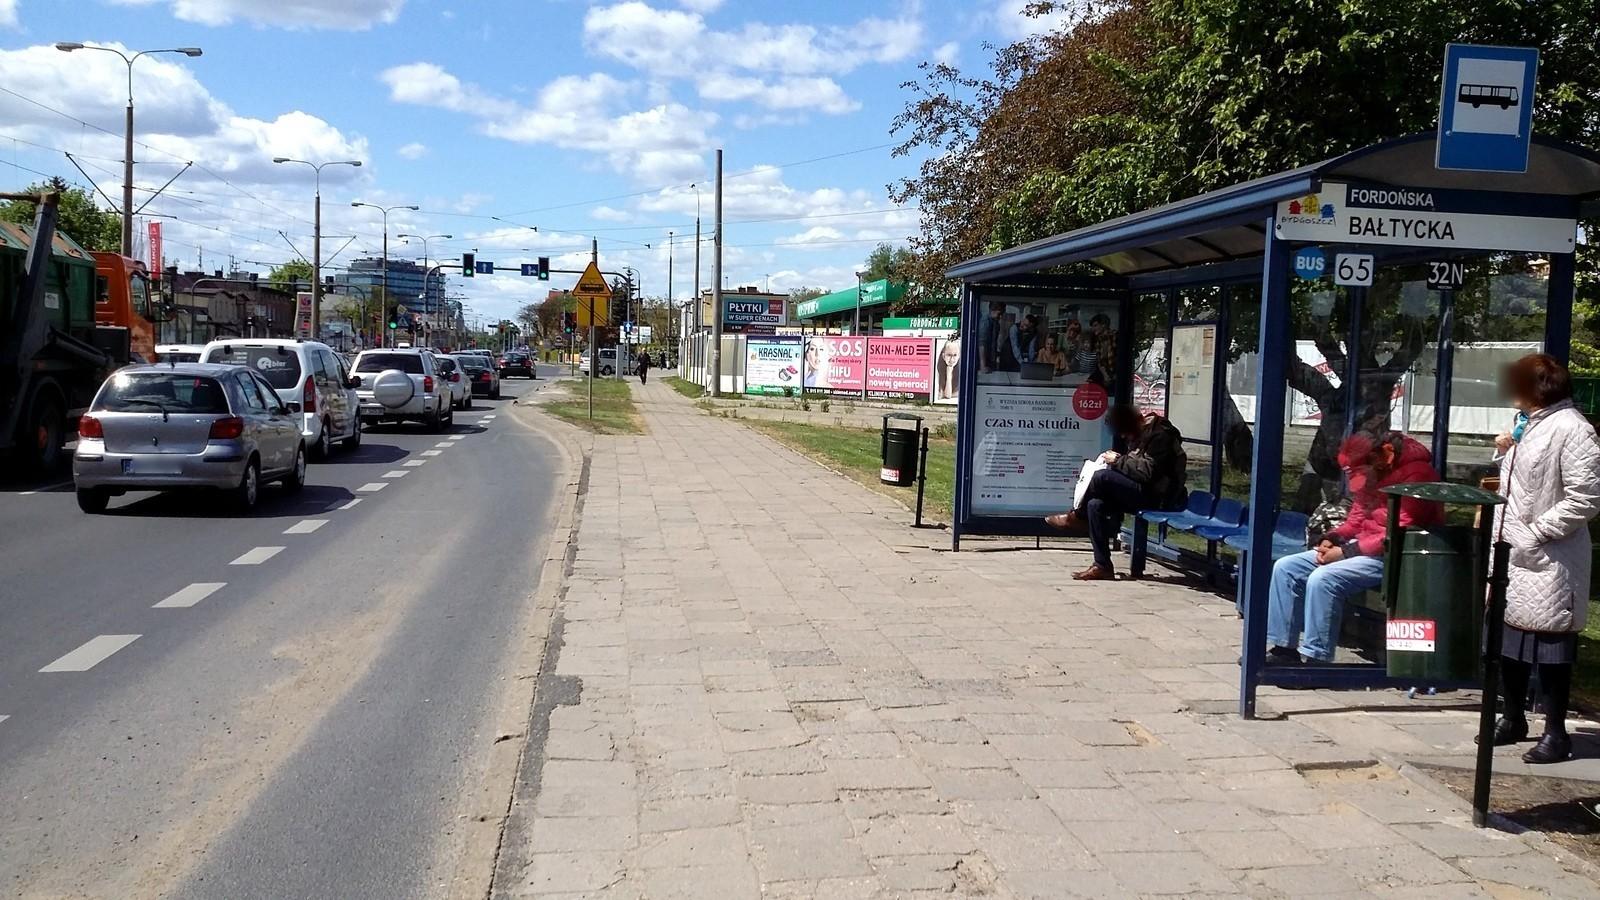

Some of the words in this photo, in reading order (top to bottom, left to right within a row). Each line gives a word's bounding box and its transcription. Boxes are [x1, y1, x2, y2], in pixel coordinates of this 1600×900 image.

[1351, 189, 1434, 207] FORDOŃSKA
[1281, 216, 1333, 225] BYDGOSZCZ
[1349, 216, 1455, 240] BAŁTYCKA
[1296, 256, 1325, 270] BUS
[1338, 258, 1370, 281] 65
[1428, 262, 1464, 284] 32N
[729, 302, 762, 313] PŁYTKI
[758, 347, 793, 359] KRASNAL
[829, 340, 863, 357] S.O.S
[869, 344, 915, 356] SKIN-MED
[829, 366, 851, 378] HIFU
[869, 367, 920, 379] Odmładzanie
[868, 379, 892, 388] nowej
[893, 380, 929, 391] generacji
[1079, 399, 1102, 408] 162zł
[984, 418, 1014, 428] czas
[1018, 419, 1034, 429] na
[1038, 417, 1080, 430] studia
